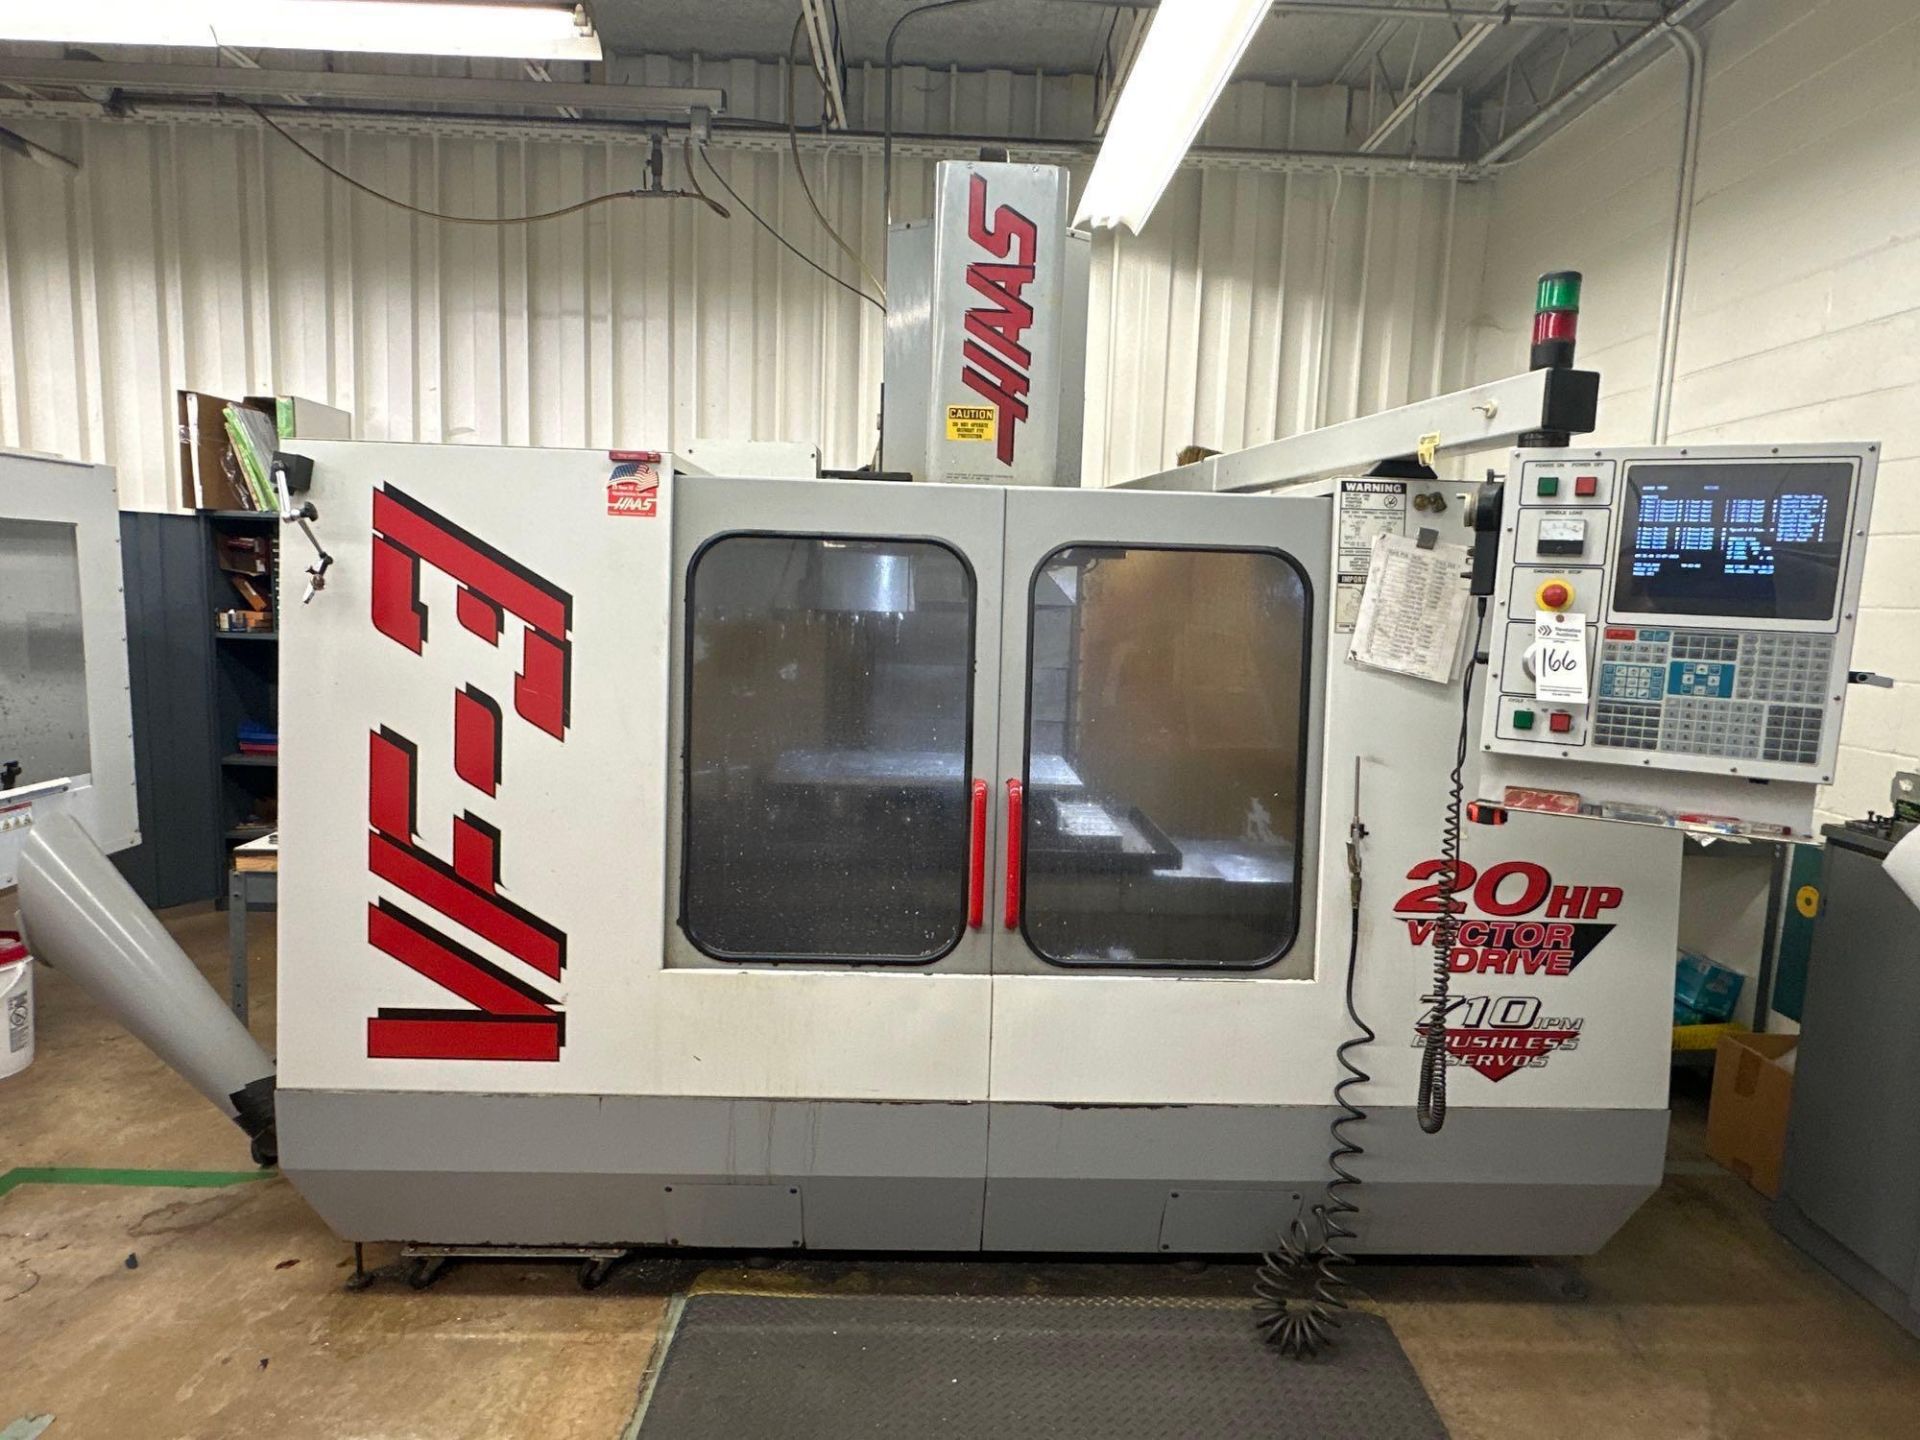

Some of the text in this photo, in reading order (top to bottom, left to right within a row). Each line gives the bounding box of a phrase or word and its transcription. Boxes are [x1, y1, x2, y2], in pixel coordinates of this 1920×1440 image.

[962, 173, 1037, 467] HAAS
[950, 409, 993, 419] CAUTION
[1345, 482, 1402, 492] WARNING
[608, 497, 656, 511] HAAS
[1341, 575, 1367, 583] IMPORT
[1542, 648, 1577, 677] 166
[367, 480, 574, 1062] VF-3
[1448, 947, 1575, 976] DRIVE
[1445, 1053, 1550, 1068] SERVOS
